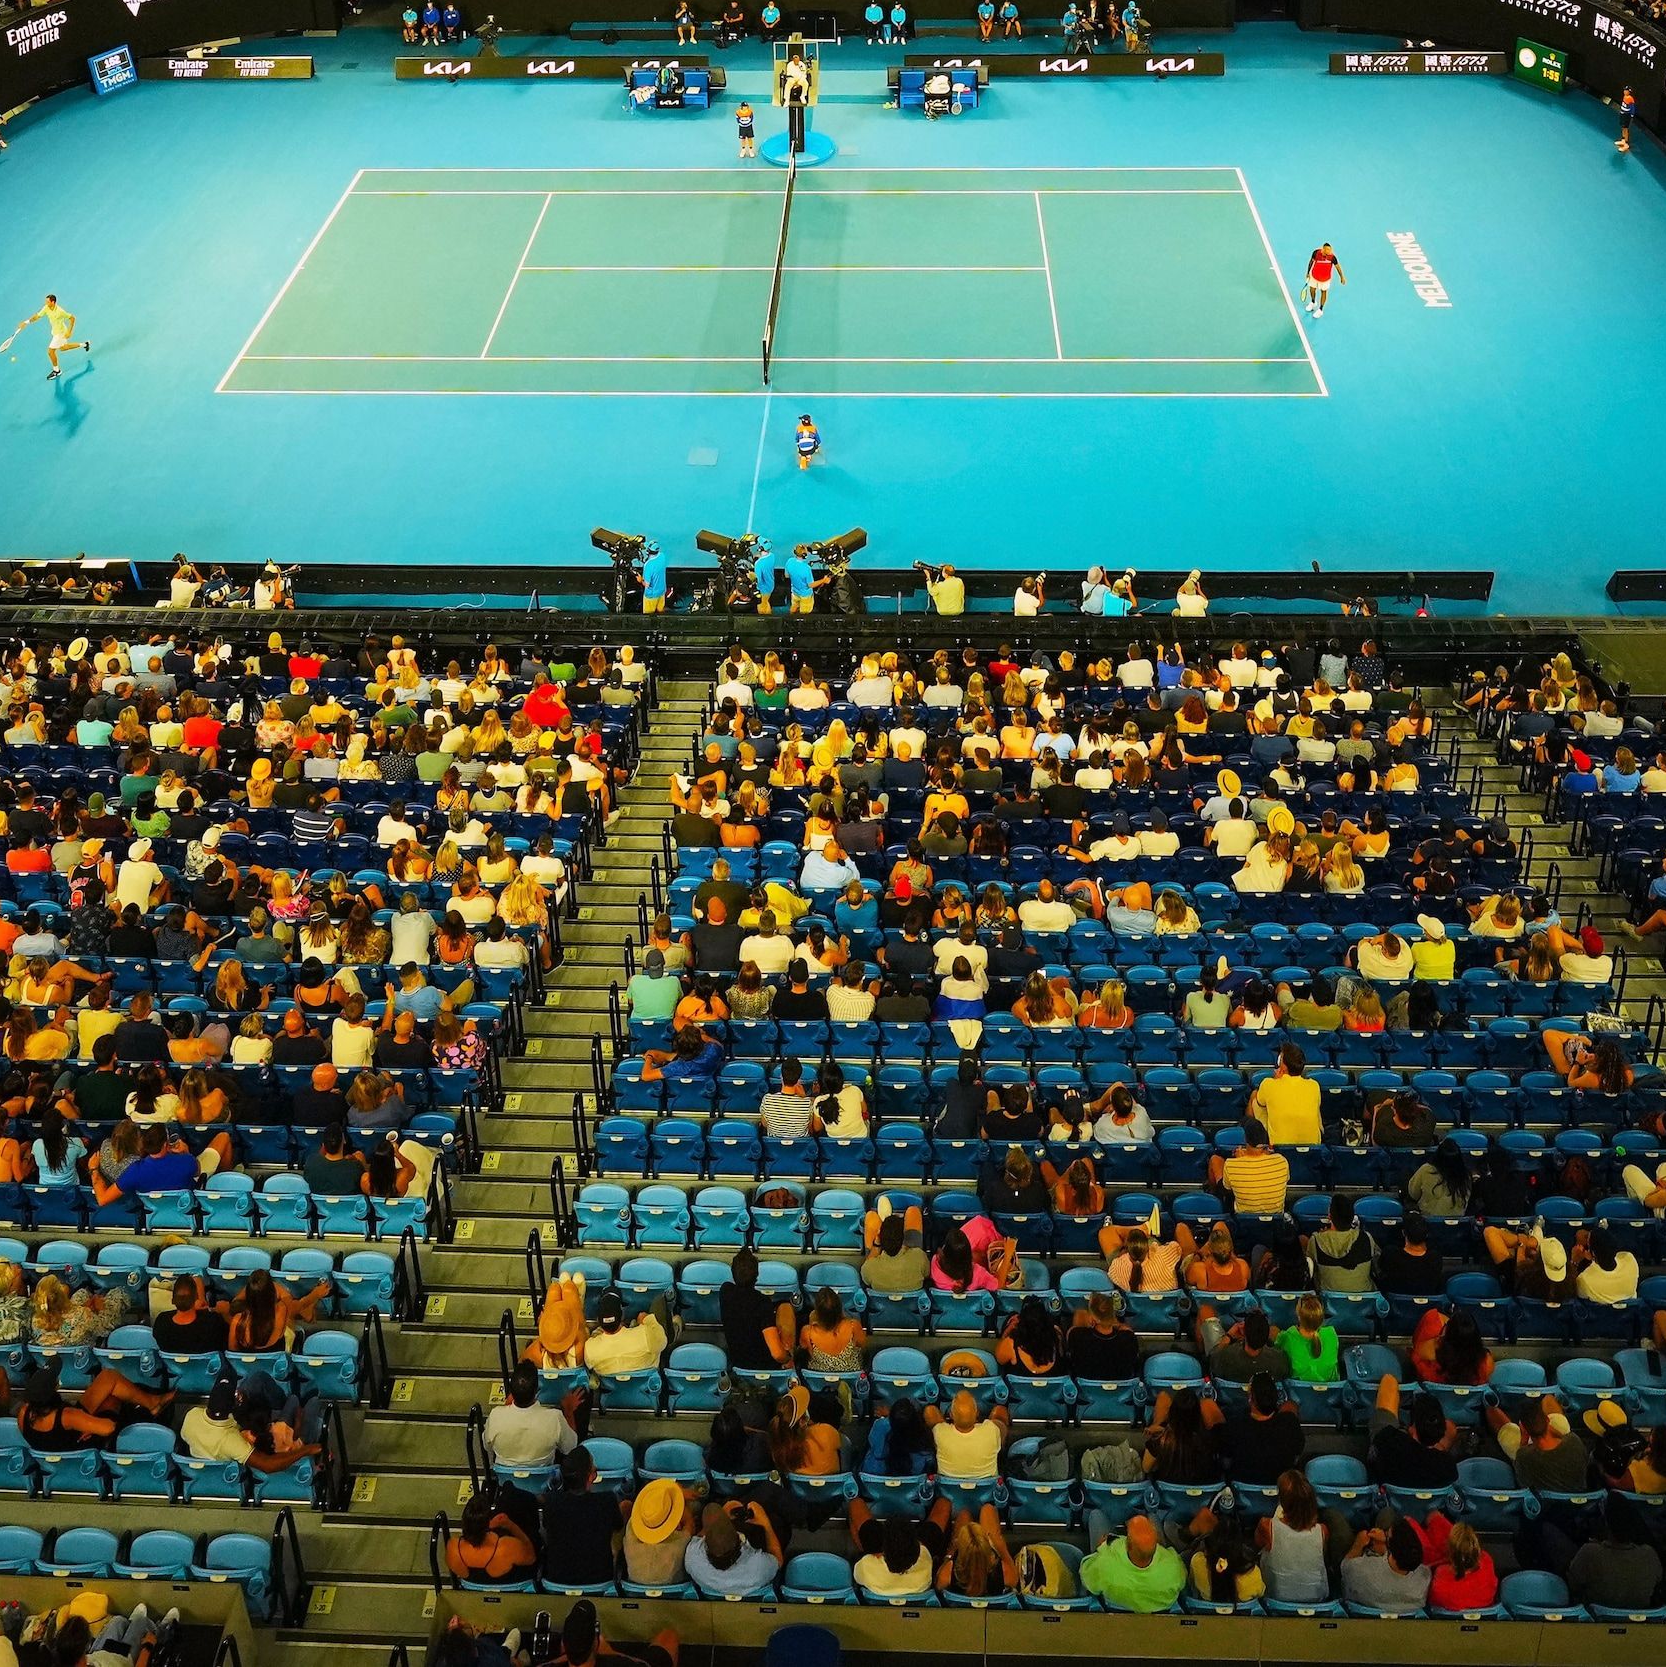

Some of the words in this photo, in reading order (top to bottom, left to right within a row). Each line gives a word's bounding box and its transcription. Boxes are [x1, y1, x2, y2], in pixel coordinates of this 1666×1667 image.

[6, 10, 68, 46] Emirates
[18, 40, 31, 57] FLY
[31, 27, 60, 50] BETTER
[168, 59, 209, 69] Emirates
[234, 59, 276, 69] Emirates
[423, 61, 471, 74] KIA
[527, 61, 574, 74] KIA
[1040, 58, 1088, 72] KIA
[1146, 58, 1195, 72] KIA
[1542, 67, 1561, 82] 1:55
[1386, 232, 1453, 307] MELBOURNE
[401, 1383, 406, 1391] R
[362, 1481, 367, 1489] S
[320, 1590, 326, 1599] T
